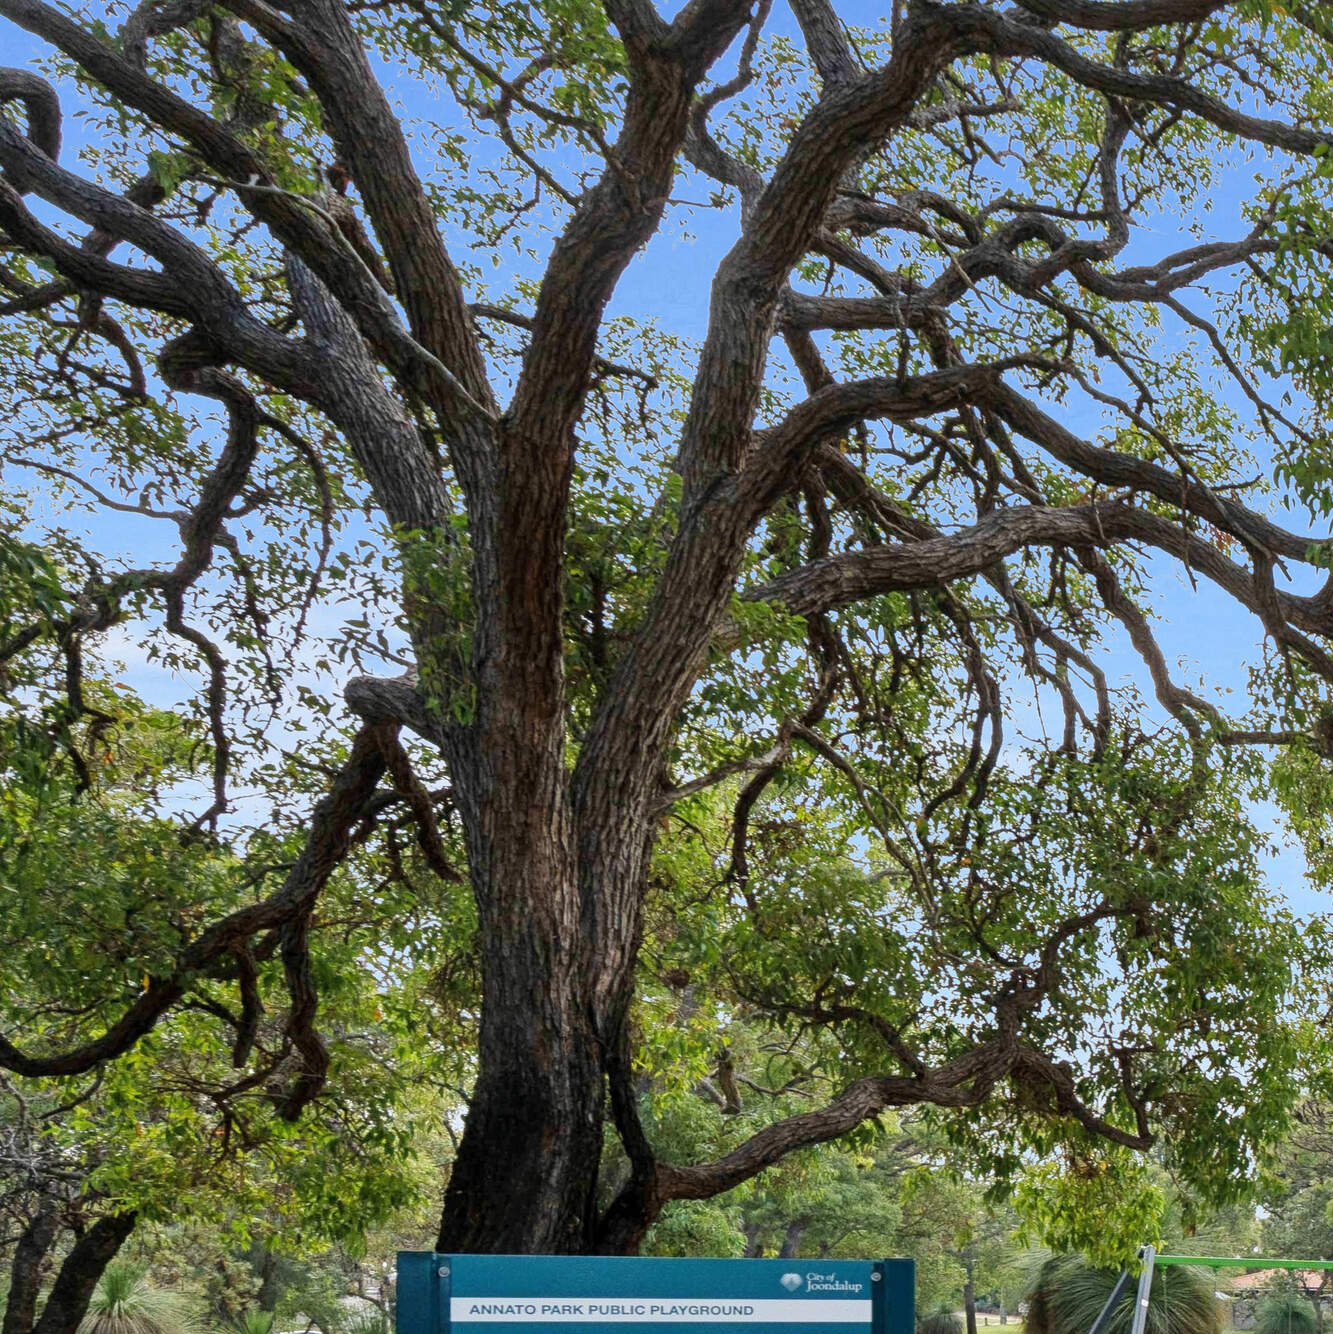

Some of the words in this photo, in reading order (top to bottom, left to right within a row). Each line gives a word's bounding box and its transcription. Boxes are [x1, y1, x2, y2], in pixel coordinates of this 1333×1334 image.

[806, 1272, 824, 1282] City
[826, 1272, 836, 1282] of
[806, 1280, 862, 1292] Joondalup
[469, 1305, 536, 1315] ANNATO
[541, 1305, 584, 1315] PARK
[589, 1305, 646, 1315] PUBLIC
[651, 1305, 754, 1316] PLAYGROUND
